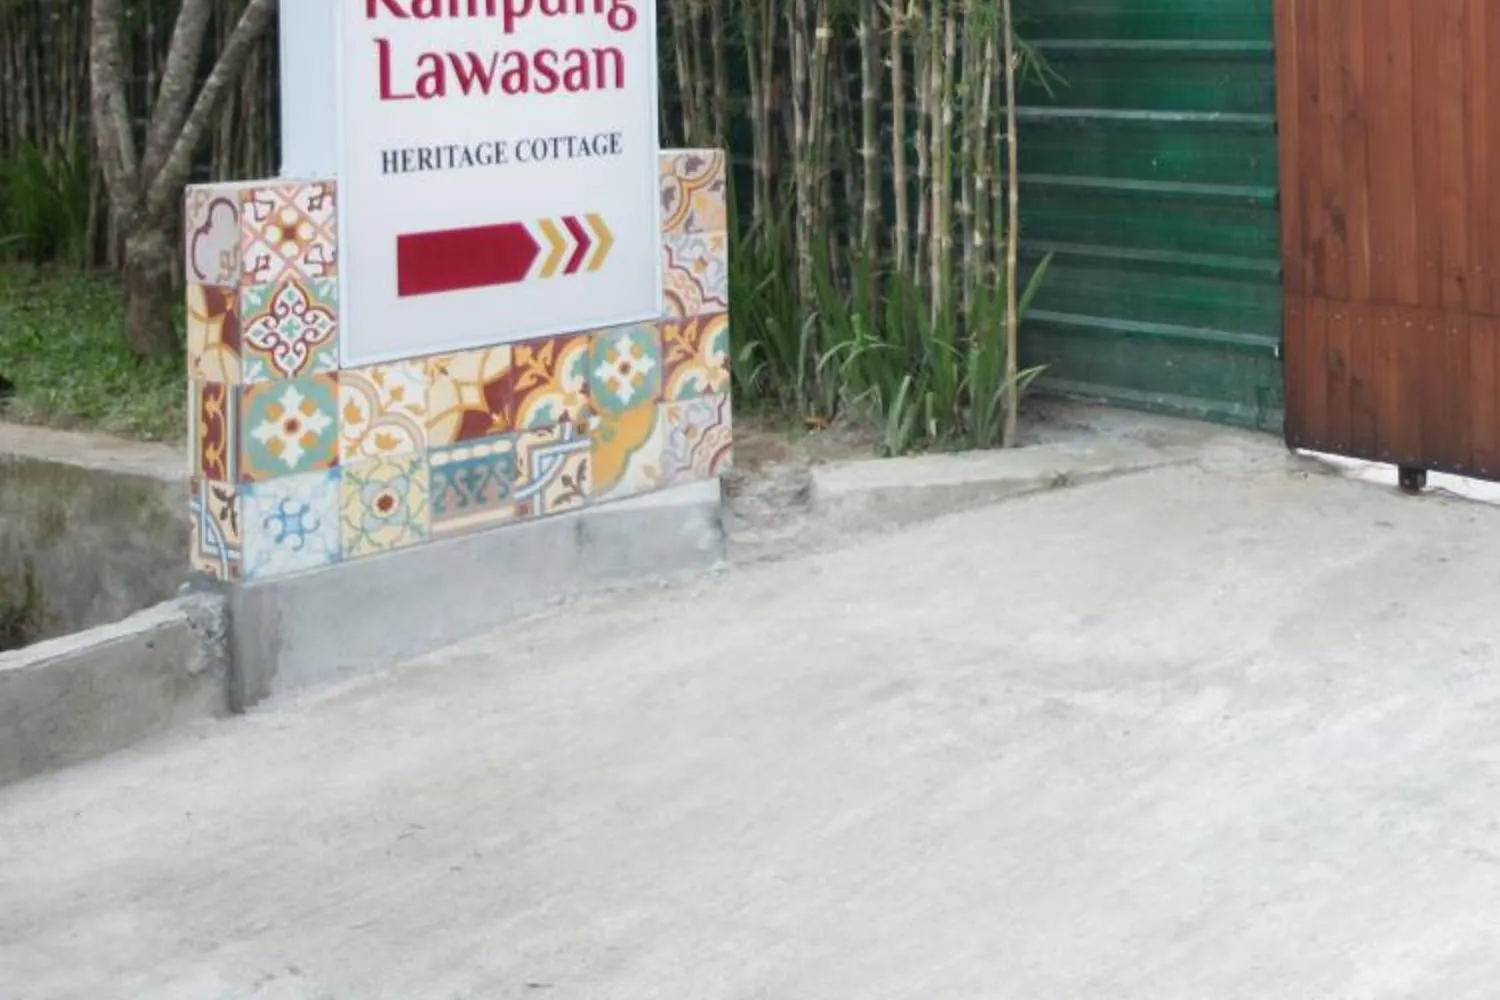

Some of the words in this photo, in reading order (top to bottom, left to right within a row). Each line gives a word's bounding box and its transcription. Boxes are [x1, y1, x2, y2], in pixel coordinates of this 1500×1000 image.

[373, 38, 625, 101] Lawasan
[382, 142, 508, 175] HERITAGE
[515, 132, 623, 162] COTTAGE
